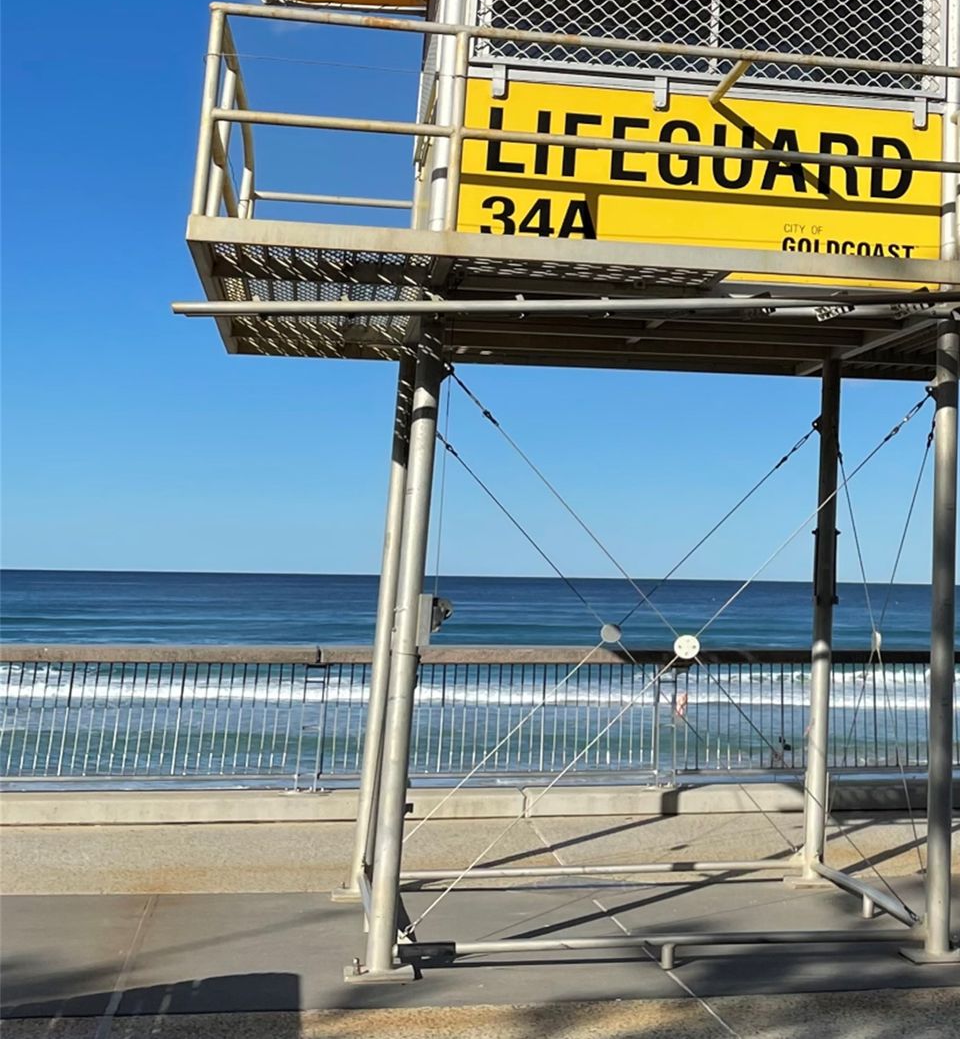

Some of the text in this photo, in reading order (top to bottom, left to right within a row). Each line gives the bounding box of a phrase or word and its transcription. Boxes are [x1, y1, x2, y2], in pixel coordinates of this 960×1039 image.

[485, 106, 914, 200] LIFEGUARD
[480, 195, 597, 240] 34A
[783, 223, 824, 235] CITY OF
